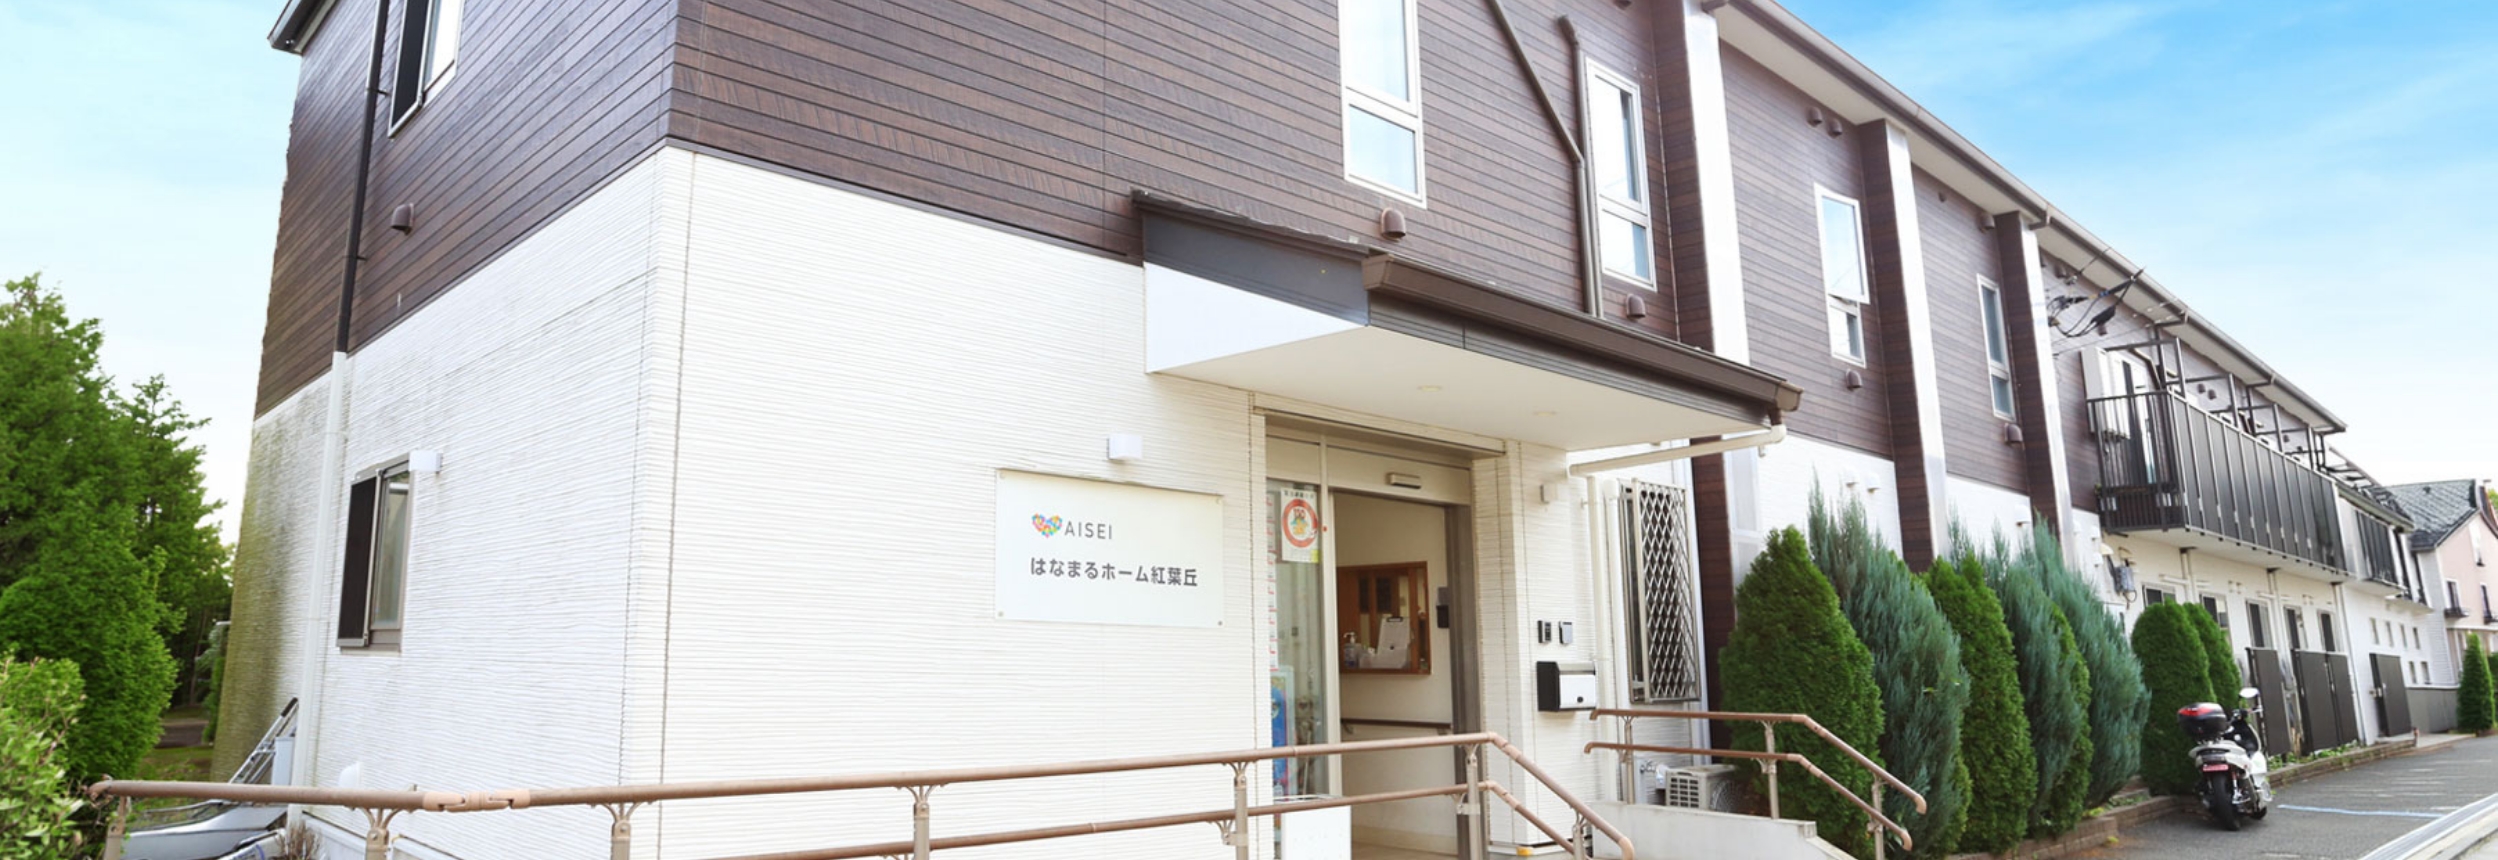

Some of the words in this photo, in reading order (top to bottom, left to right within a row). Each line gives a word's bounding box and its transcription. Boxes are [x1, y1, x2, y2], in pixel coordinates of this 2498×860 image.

[1064, 521, 1112, 540] AISEI
[1030, 557, 1198, 587] はなまるホーム紅葉丘
